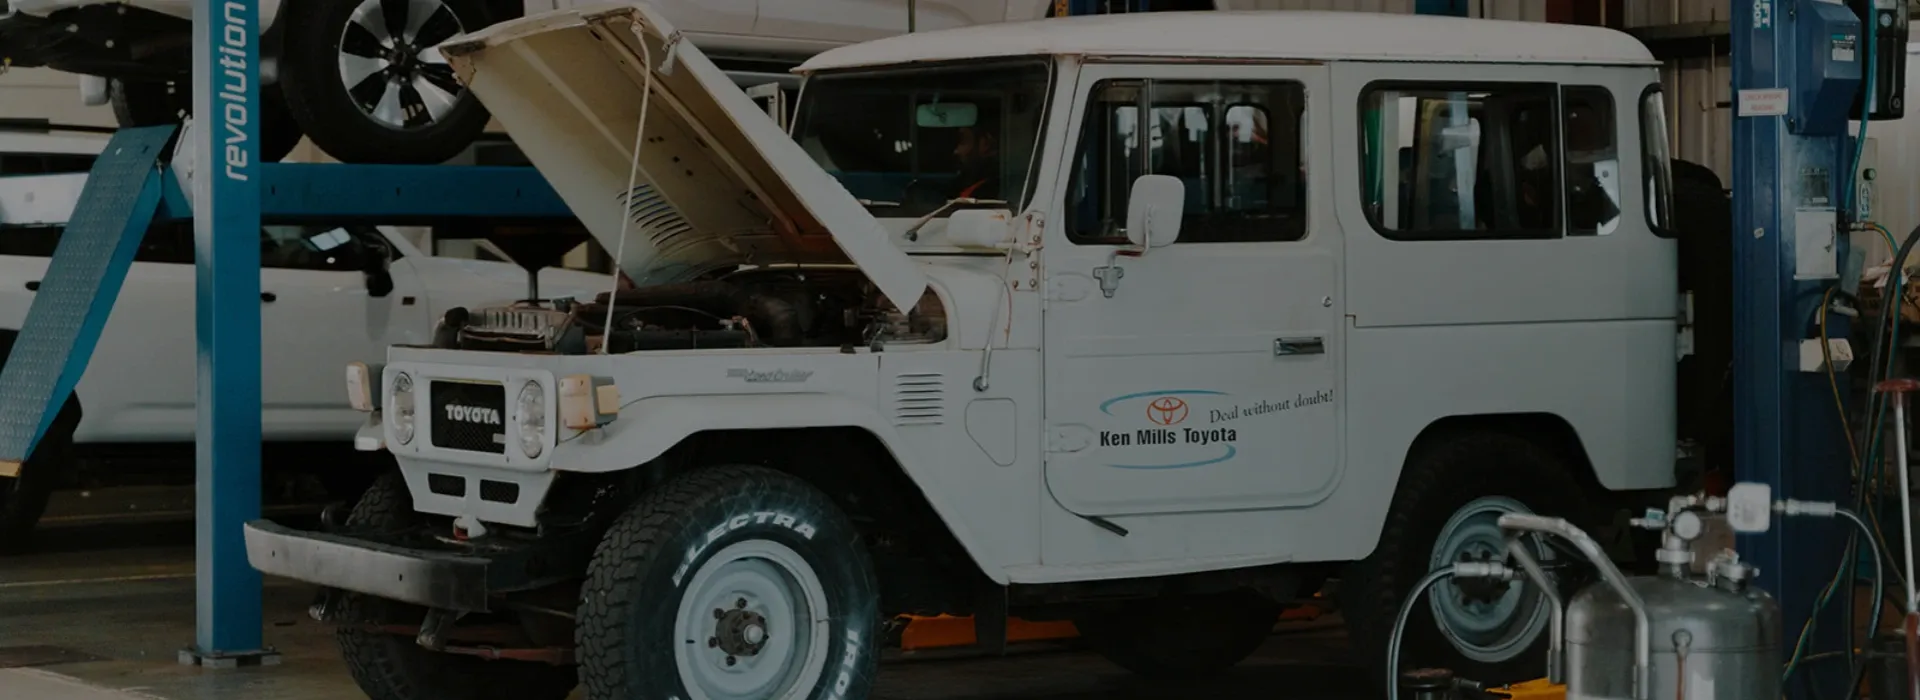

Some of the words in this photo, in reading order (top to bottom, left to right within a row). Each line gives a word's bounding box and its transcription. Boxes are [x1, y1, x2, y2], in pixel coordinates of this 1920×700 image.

[219, 1, 248, 181] revolution
[445, 404, 501, 425] TOYOTA
[1210, 406, 1239, 423] Deal
[1243, 398, 1291, 417] without
[1294, 389, 1334, 407] doubt!
[1100, 431, 1131, 446] Ken
[1137, 429, 1177, 444] Mills
[1183, 428, 1237, 445] Toyota
[827, 628, 859, 700] IRO
